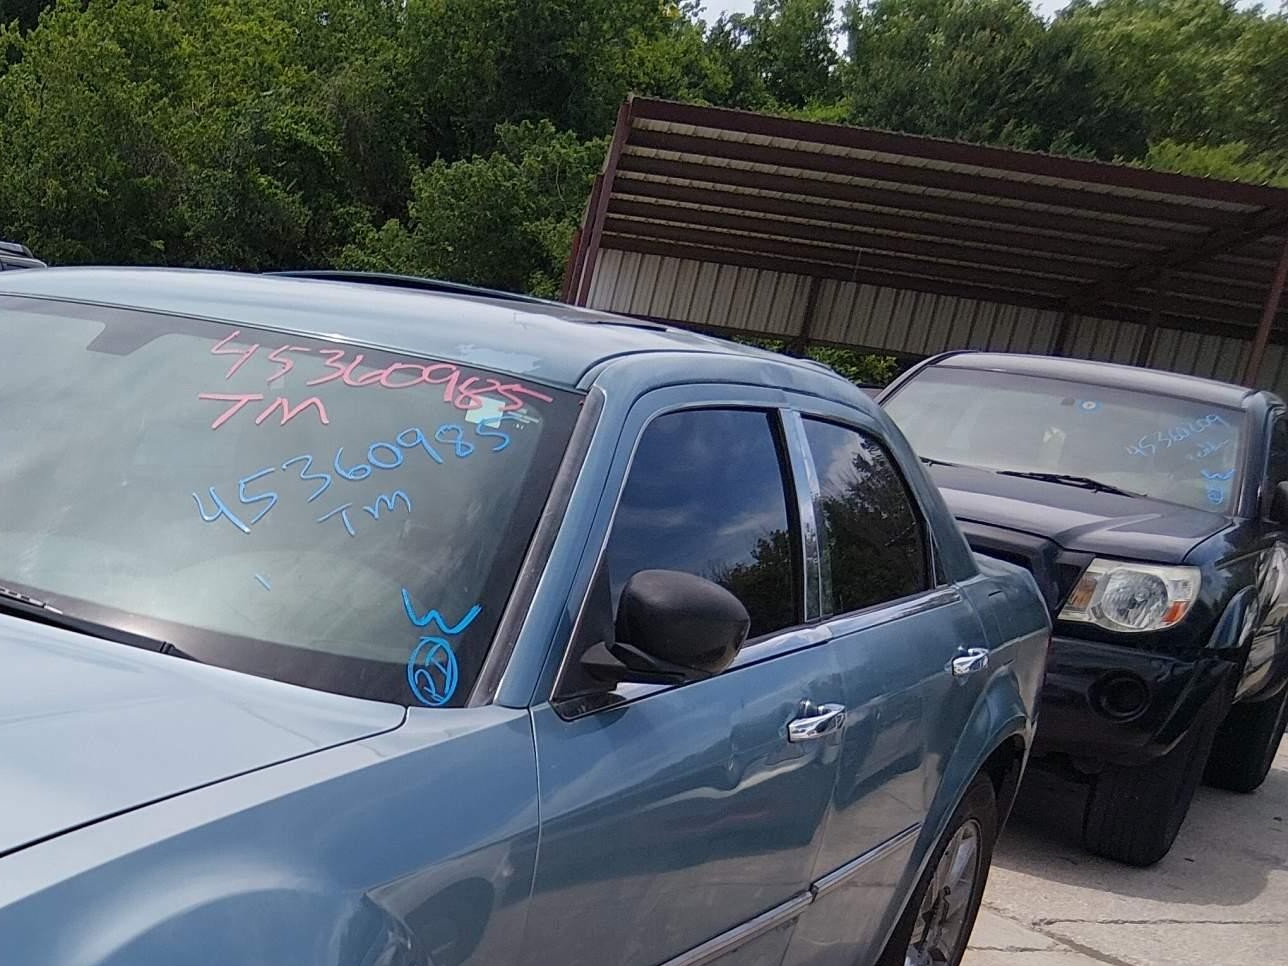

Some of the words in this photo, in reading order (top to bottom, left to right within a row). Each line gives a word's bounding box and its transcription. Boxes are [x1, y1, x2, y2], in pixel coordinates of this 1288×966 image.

[210, 330, 554, 412] 45360985
[198, 392, 330, 430] TM
[192, 415, 524, 535] 45360985
[317, 489, 411, 537] TM
